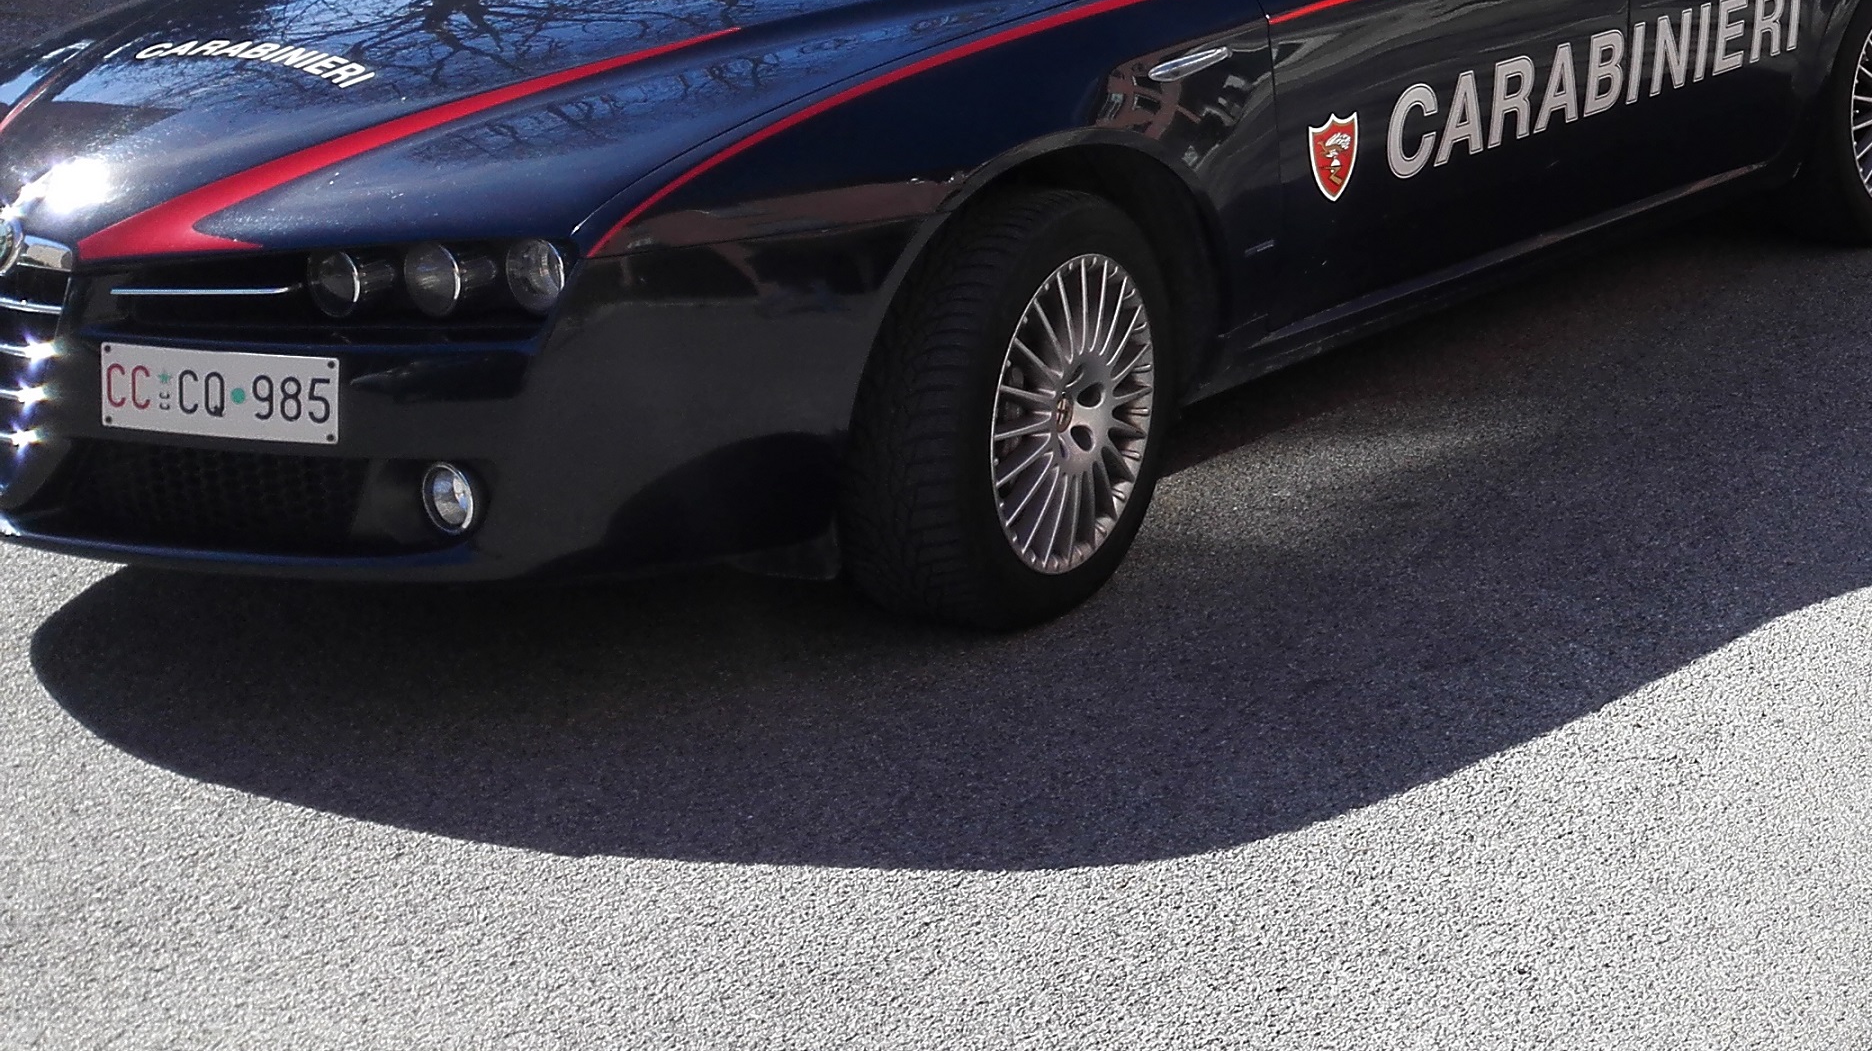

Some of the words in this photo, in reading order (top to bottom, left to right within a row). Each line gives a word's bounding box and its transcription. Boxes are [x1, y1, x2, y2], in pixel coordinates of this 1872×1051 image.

[135, 39, 376, 88] CARABINIERI
[106, 363, 151, 409] CC
[178, 369, 225, 417] CQ
[252, 374, 332, 424] 985
